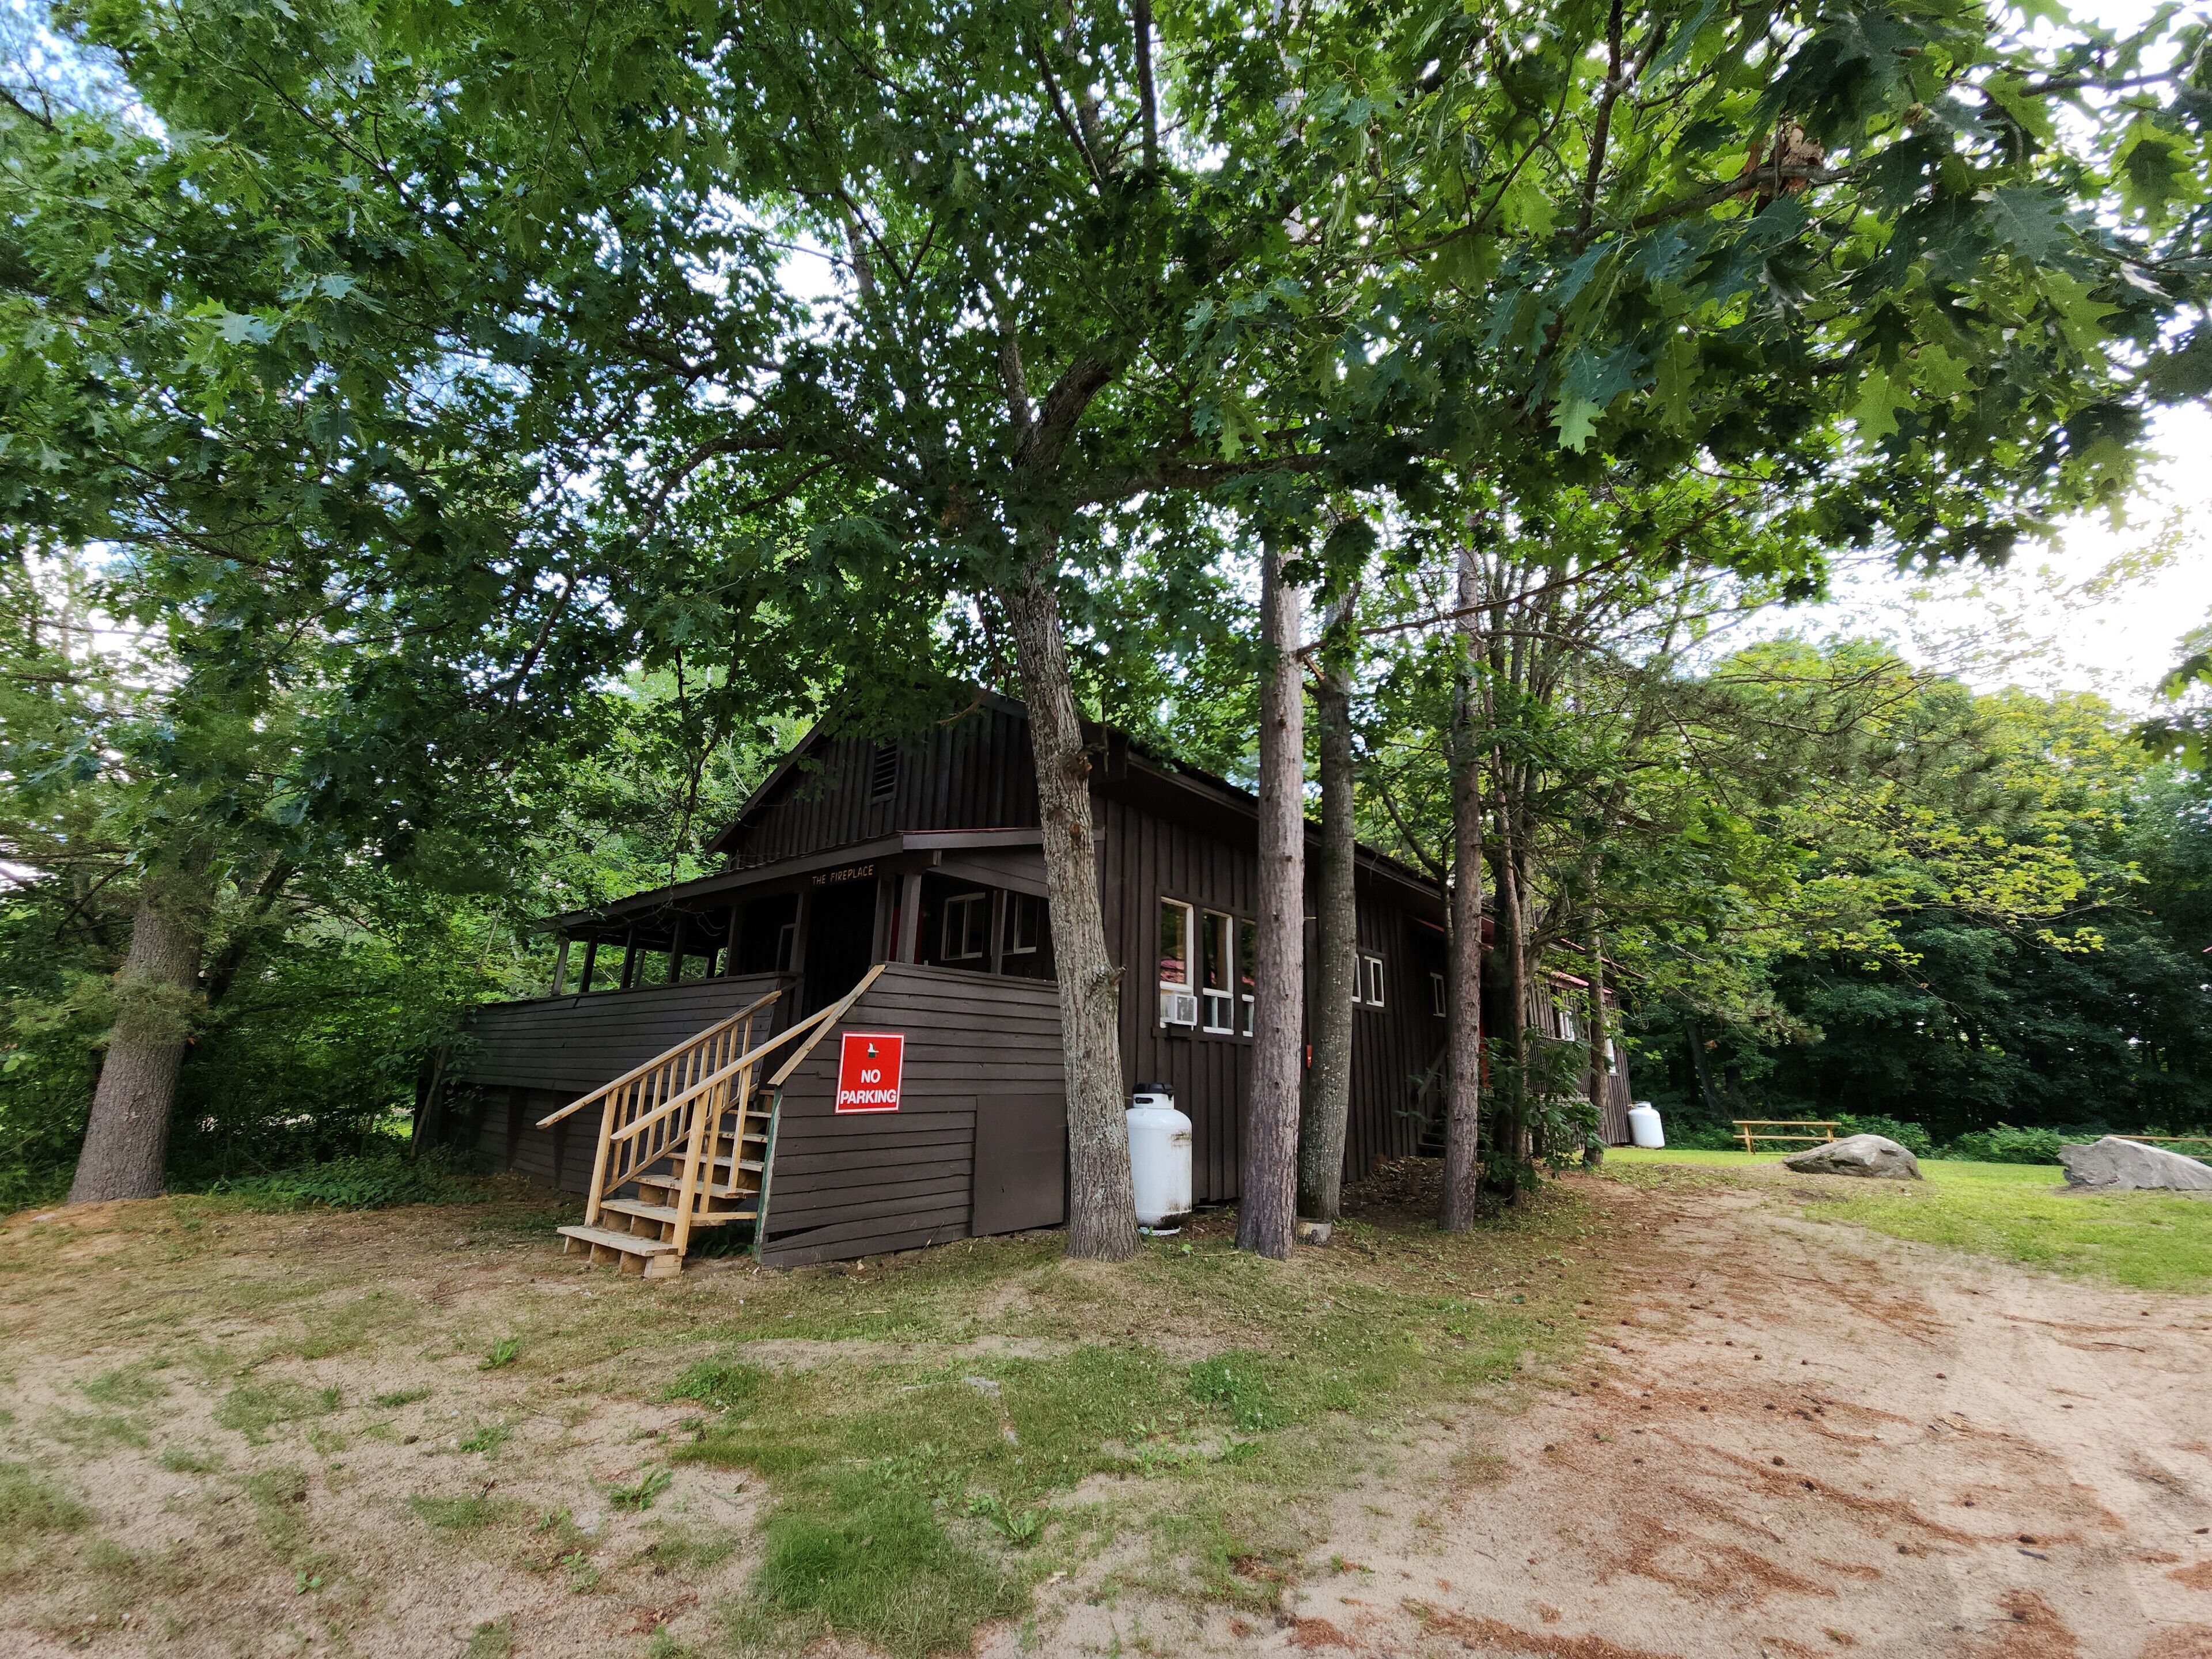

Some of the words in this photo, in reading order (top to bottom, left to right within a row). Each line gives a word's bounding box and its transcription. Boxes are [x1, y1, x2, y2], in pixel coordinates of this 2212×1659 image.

[812, 874, 826, 885] THE
[830, 865, 874, 882] FIREPLACE
[861, 1069, 881, 1083] NO
[840, 1089, 896, 1104] PARKING
